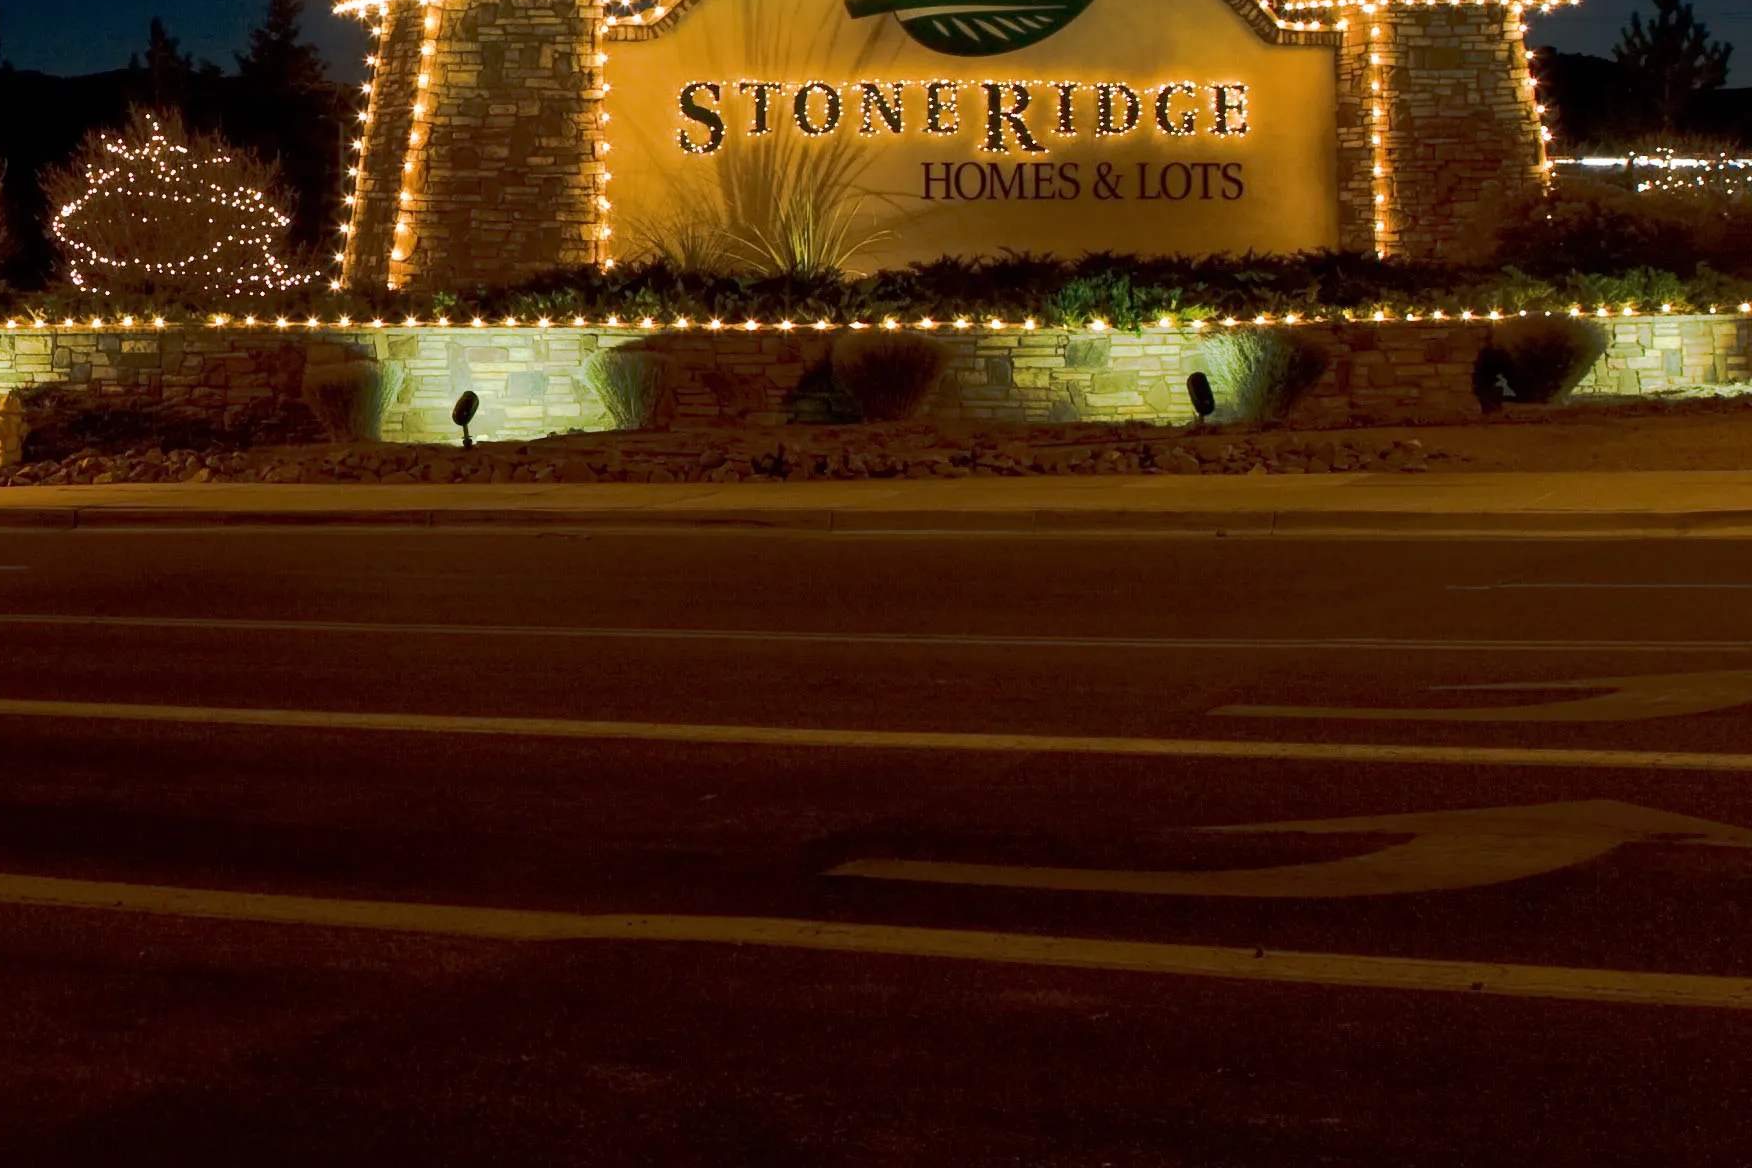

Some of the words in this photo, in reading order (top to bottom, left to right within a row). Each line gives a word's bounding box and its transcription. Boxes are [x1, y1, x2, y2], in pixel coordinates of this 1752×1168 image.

[920, 161, 1081, 200] HOMES
[1092, 161, 1124, 200] &
[1136, 161, 1245, 200] LOTS
